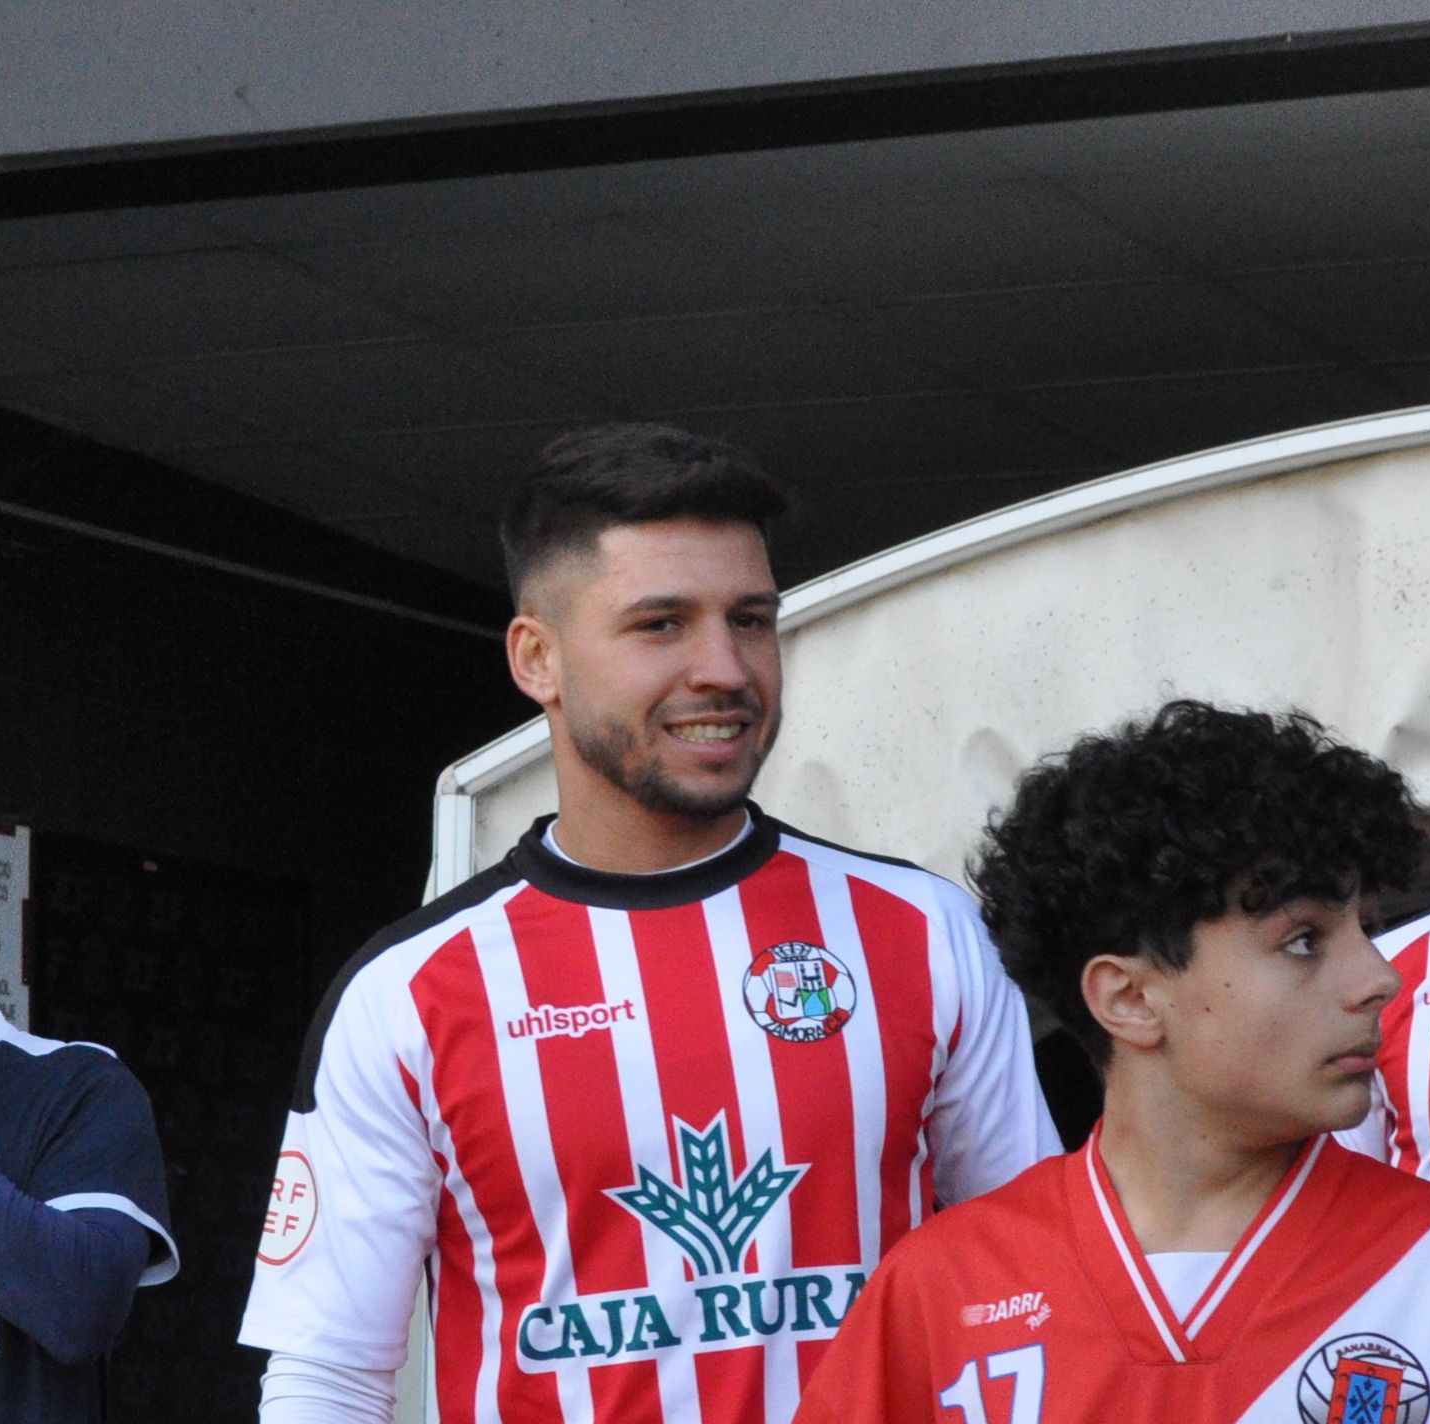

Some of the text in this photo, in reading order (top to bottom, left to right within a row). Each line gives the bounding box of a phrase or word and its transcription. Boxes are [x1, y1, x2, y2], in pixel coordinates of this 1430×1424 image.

[507, 999, 636, 1038] uhlsport
[762, 1020, 826, 1042] ZAMORA
[521, 1295, 681, 1361] CAJA
